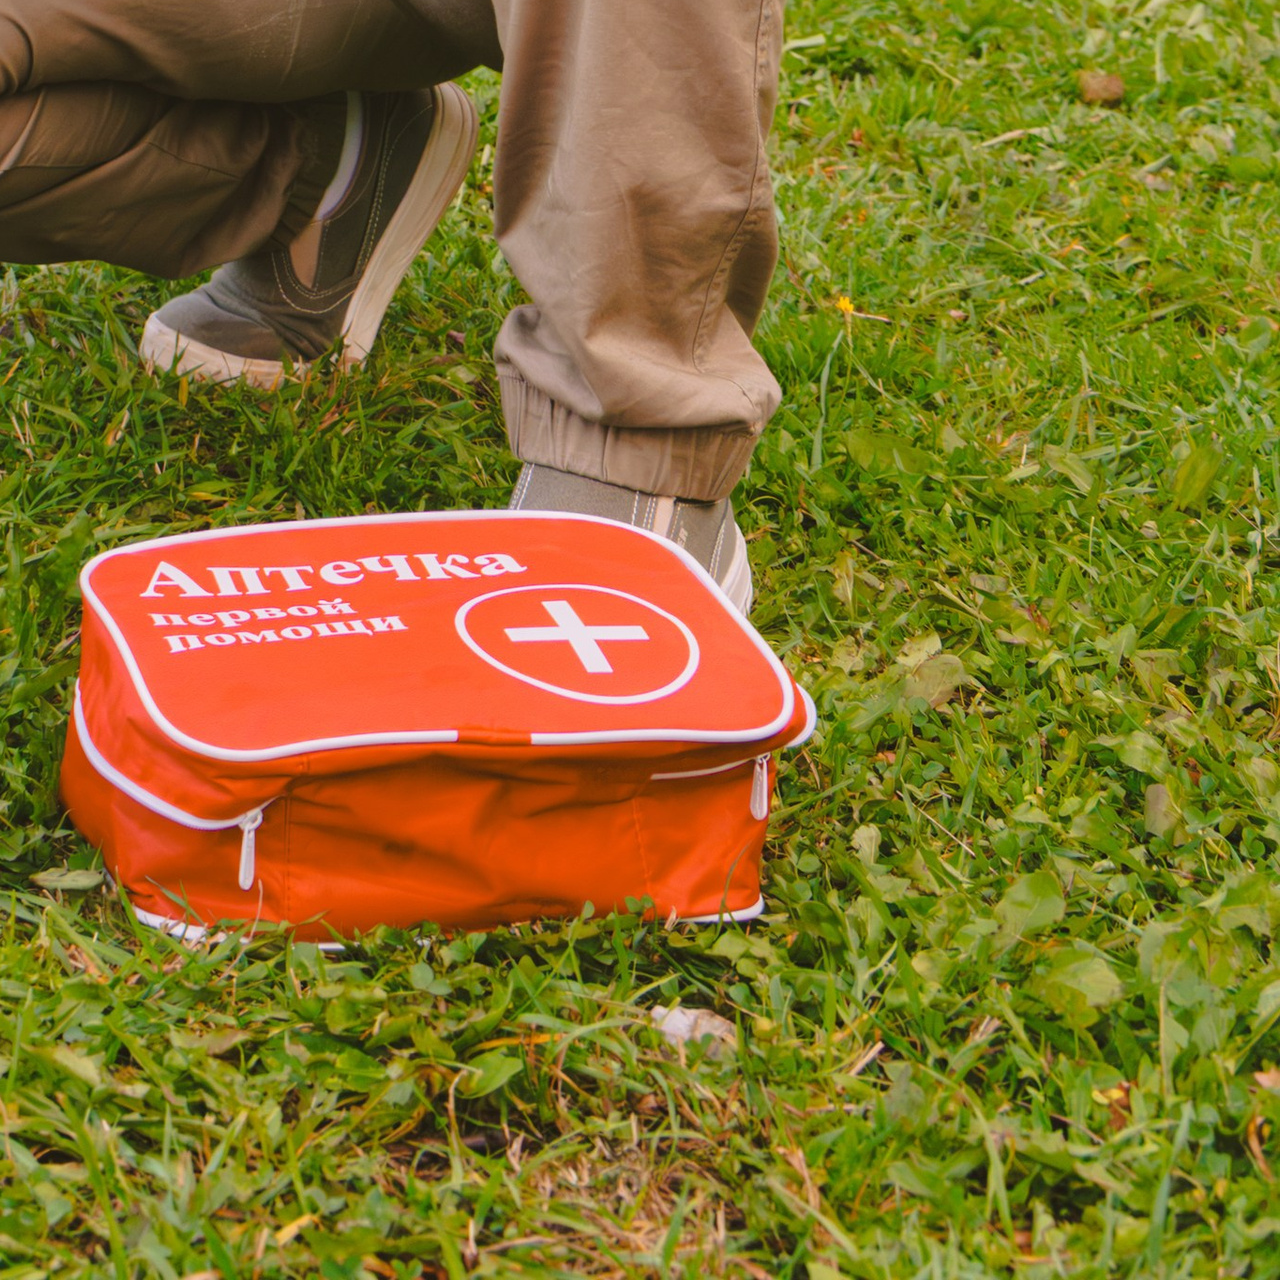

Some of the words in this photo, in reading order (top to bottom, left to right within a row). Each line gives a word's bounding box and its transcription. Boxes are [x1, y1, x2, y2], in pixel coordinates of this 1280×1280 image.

[139, 552, 528, 597] Аптечка
[149, 597, 358, 628] первой
[163, 615, 409, 653] помощи
